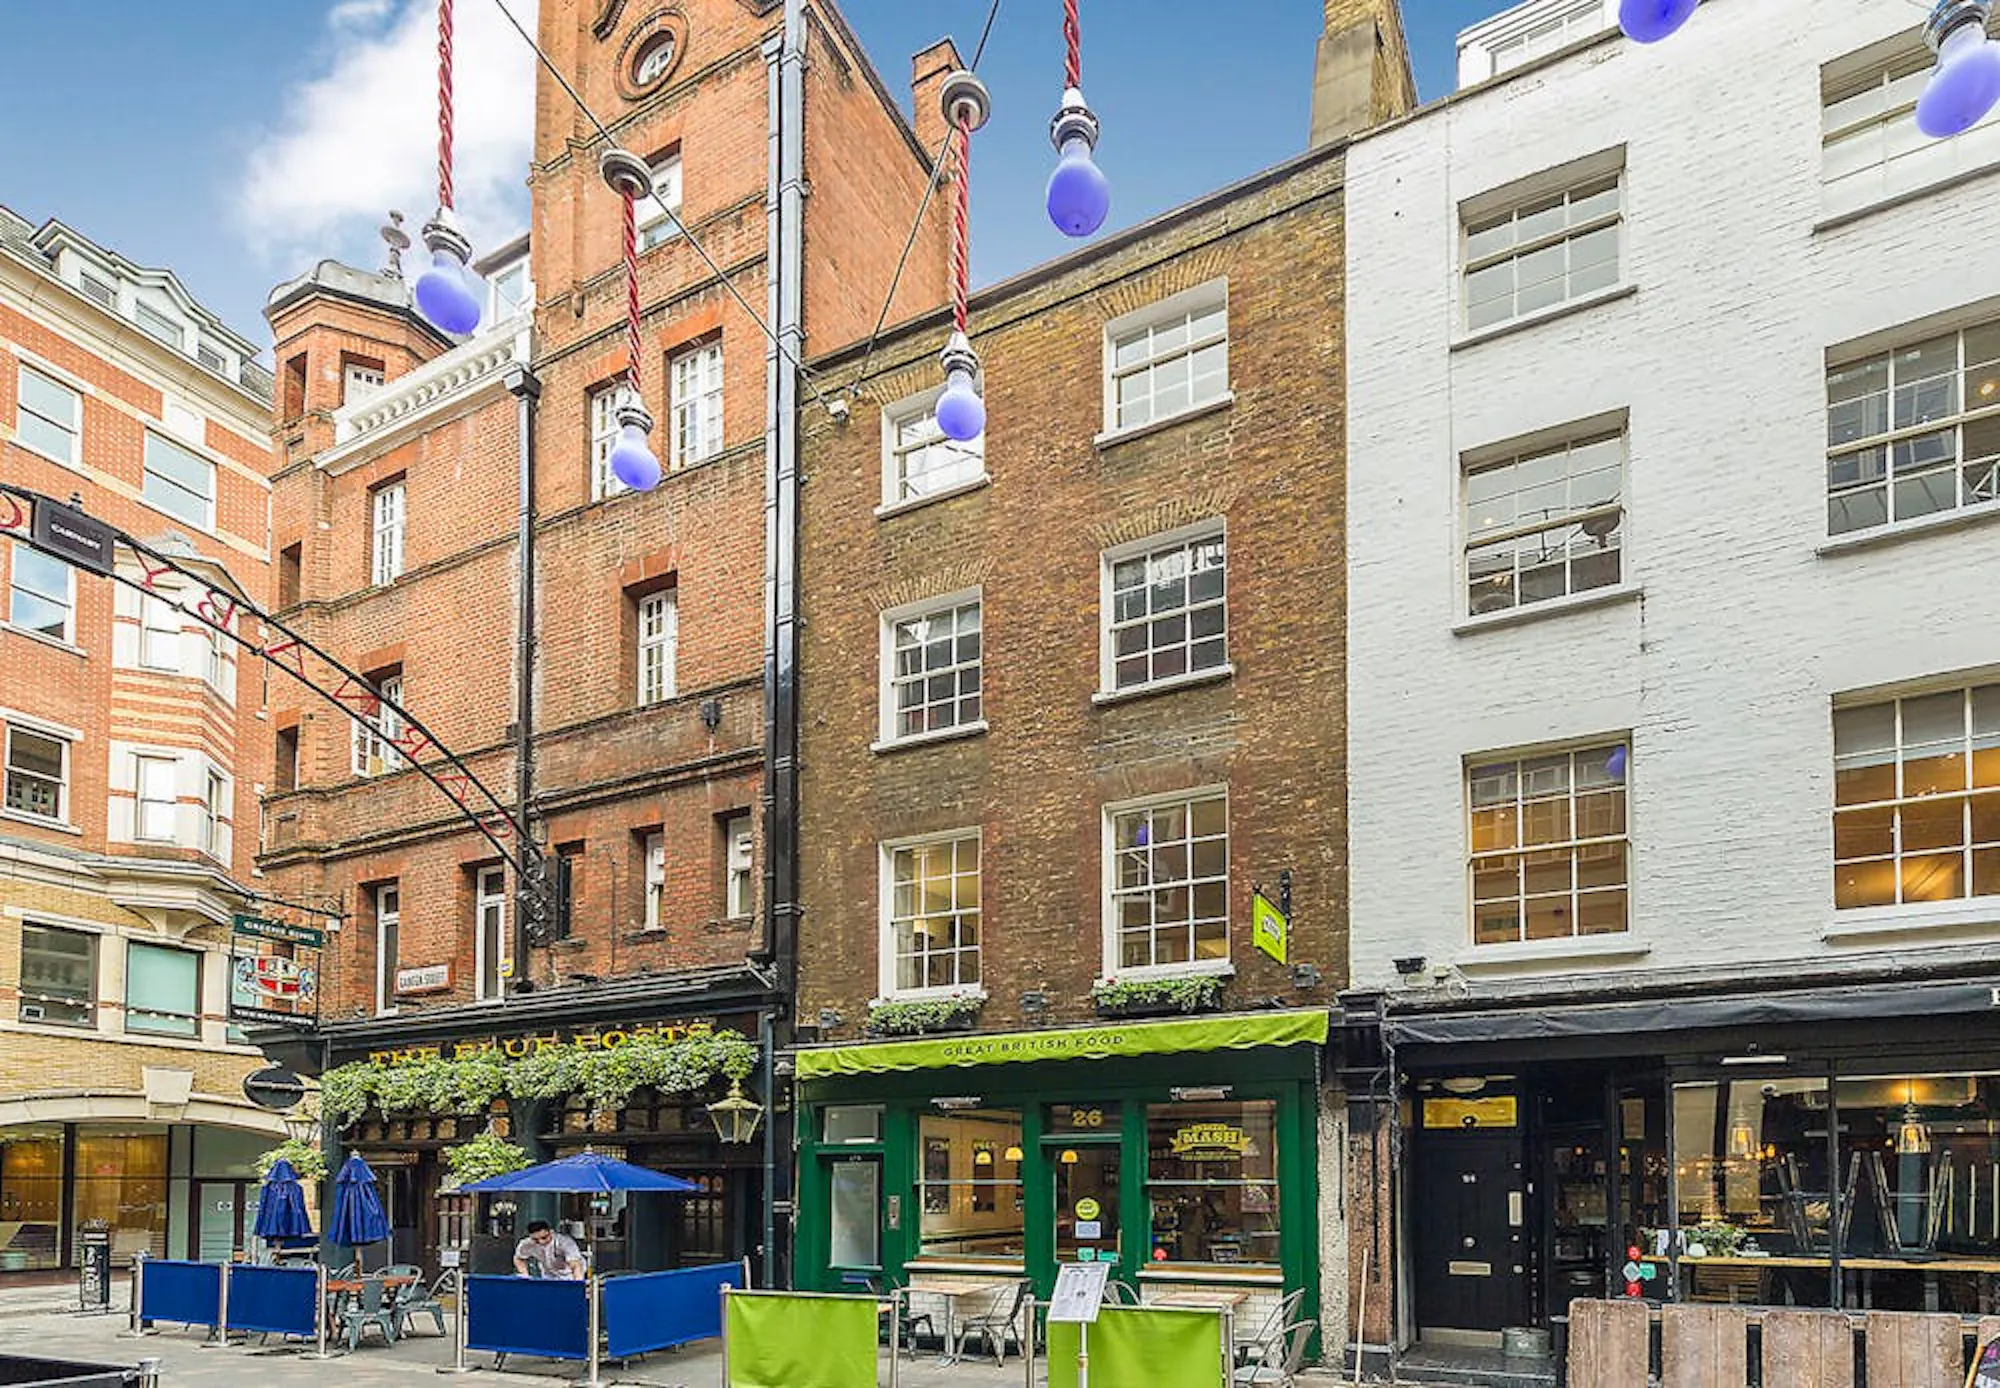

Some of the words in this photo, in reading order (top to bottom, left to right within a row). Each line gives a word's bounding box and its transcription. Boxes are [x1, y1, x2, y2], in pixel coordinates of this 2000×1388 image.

[368, 1044, 441, 1067] THE
[943, 1046, 994, 1057] GREAT
[1001, 1040, 1068, 1053] BRITISH
[1075, 1035, 1124, 1050] FOOD
[1071, 1108, 1103, 1127] 26
[1181, 1131, 1238, 1144] MASH
